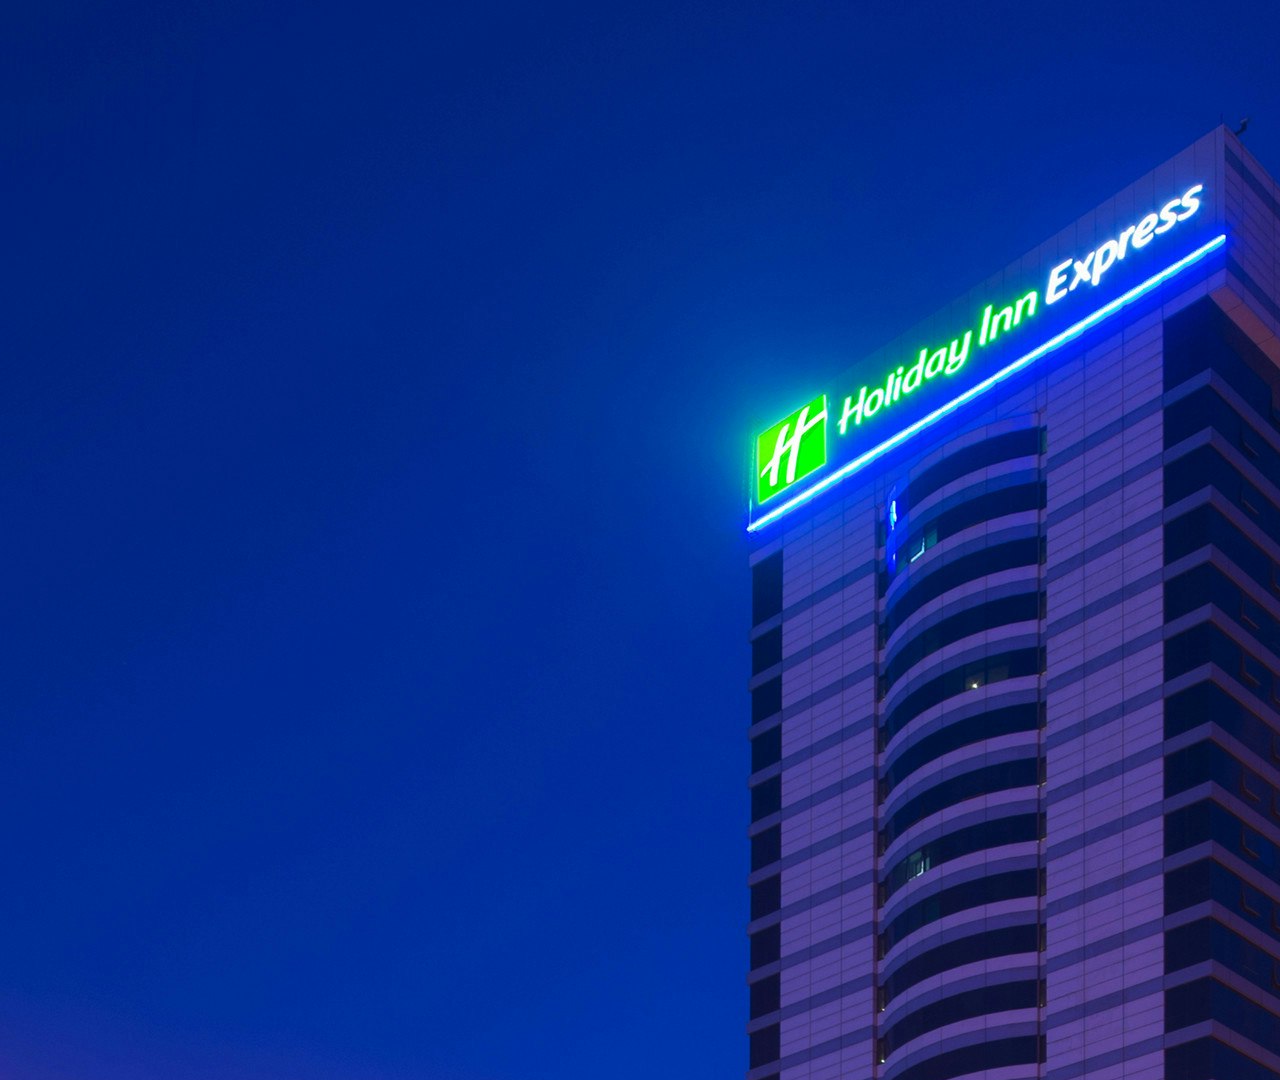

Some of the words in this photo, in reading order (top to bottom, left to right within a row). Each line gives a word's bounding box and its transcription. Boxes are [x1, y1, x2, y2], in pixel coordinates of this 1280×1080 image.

[838, 330, 972, 435] Holiday
[978, 290, 1038, 347] Inn
[1045, 184, 1203, 305] Express
